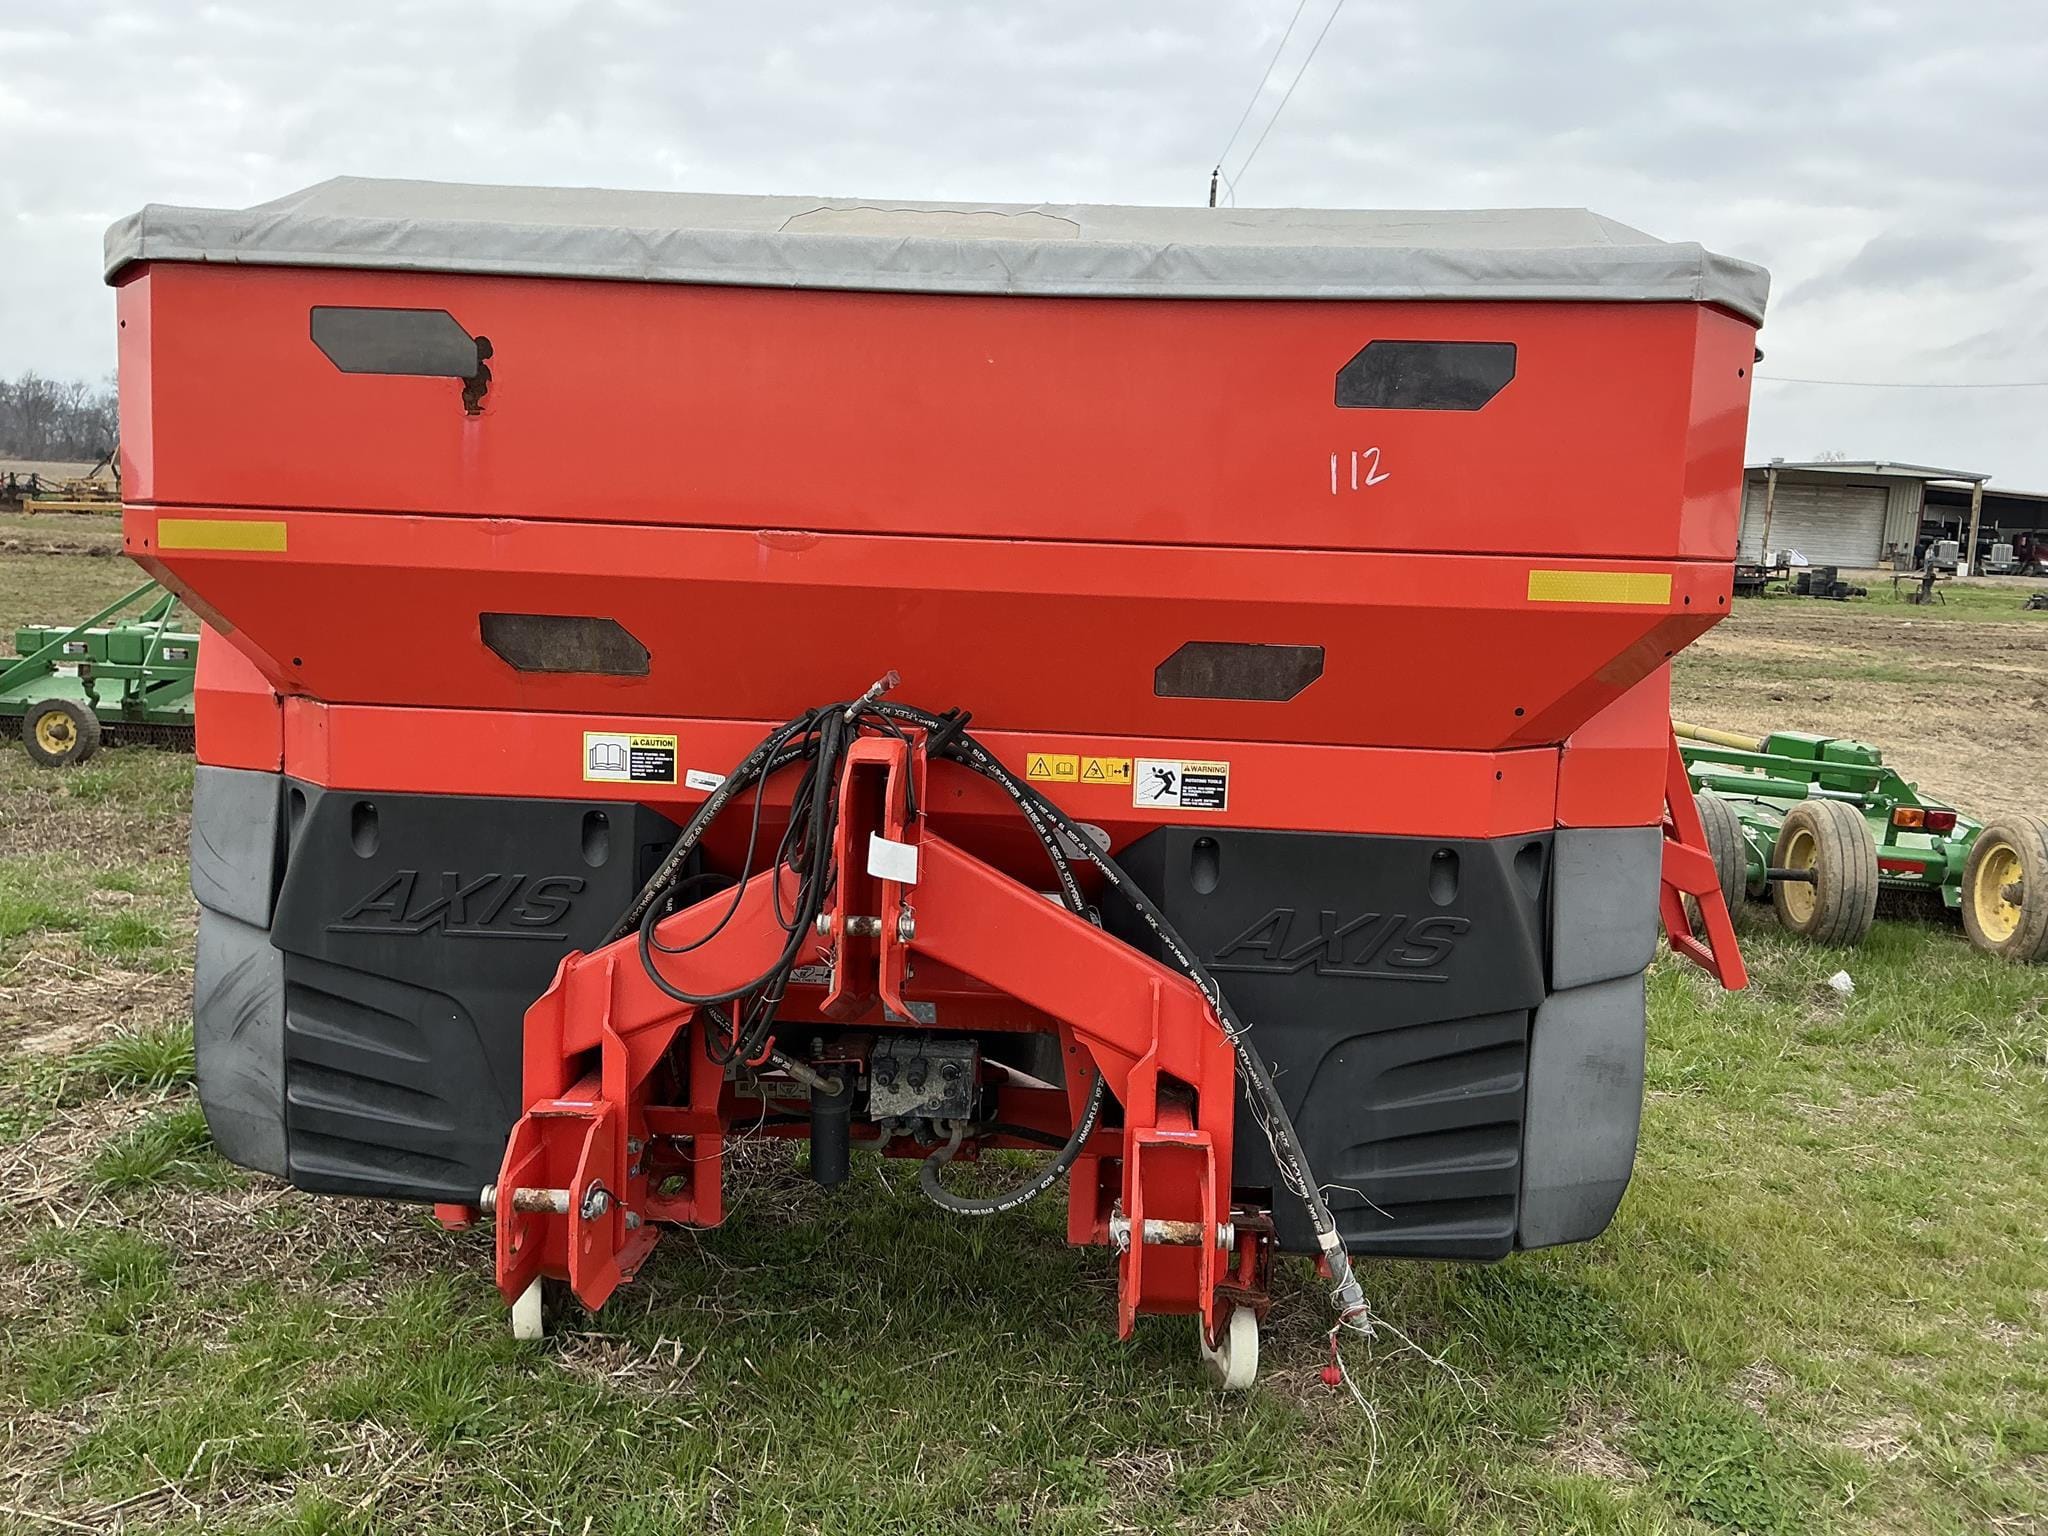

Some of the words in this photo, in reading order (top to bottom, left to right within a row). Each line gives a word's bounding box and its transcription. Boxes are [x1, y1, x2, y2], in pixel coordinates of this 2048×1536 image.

[1330, 446, 1391, 495] 112
[640, 739, 673, 747] CAUTION
[1190, 765, 1225, 774] WARNING
[1005, 780, 1020, 798] MSHA
[701, 789, 728, 824] HANSA-FLEX
[1020, 799, 1033, 814] BAR
[1046, 814, 1057, 822] WP
[694, 825, 703, 835] KP
[1036, 823, 1046, 834] WP
[1078, 842, 1087, 851] KP
[671, 857, 680, 867] WP
[1057, 860, 1066, 870] KP
[1085, 851, 1119, 884] HANSA-FLEX
[653, 874, 666, 888] BAR
[342, 870, 585, 927] AXIS
[1064, 872, 1083, 910] HANSA-FLEX
[1215, 907, 1472, 967] AXIS
[1174, 948, 1189, 967] MSHA
[1189, 969, 1202, 984] BAR
[1206, 994, 1216, 1006] WP
[772, 1055, 783, 1063] WP
[1078, 1102, 1098, 1143] HANSA-FLEX
[1095, 1087, 1102, 1098] KP
[1040, 1175, 1055, 1189] 4Q16
[1296, 1176, 1310, 1199] MSHA
[1307, 1204, 1318, 1220] BAR
